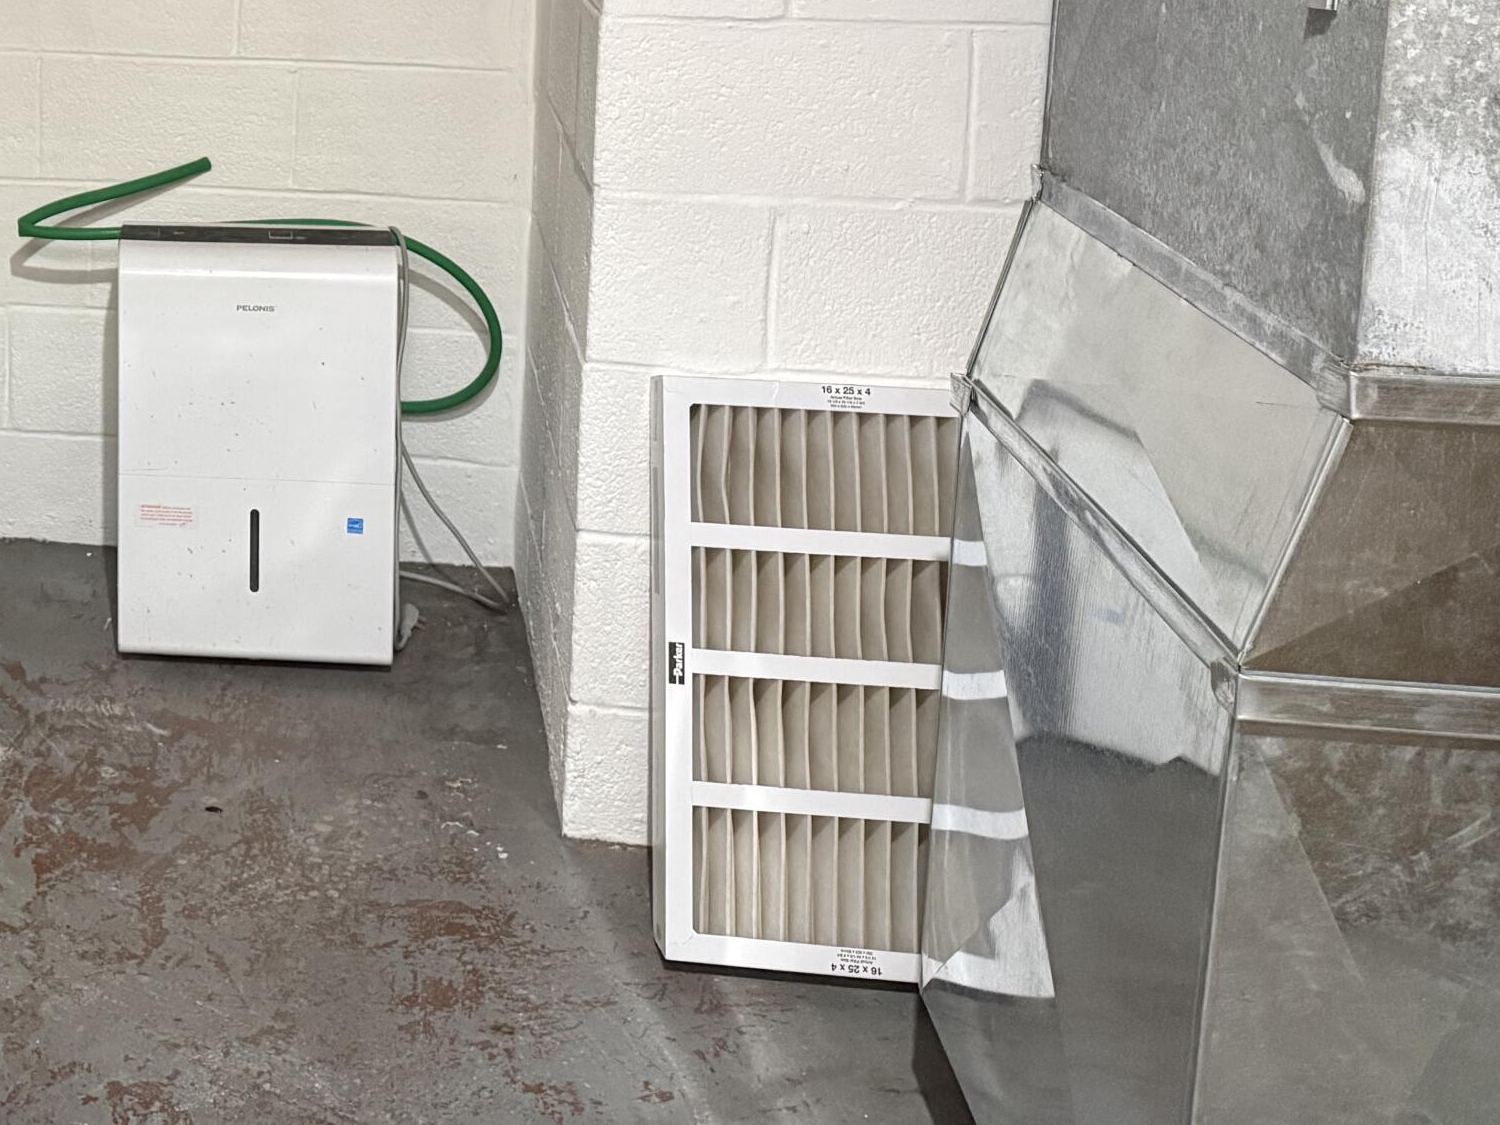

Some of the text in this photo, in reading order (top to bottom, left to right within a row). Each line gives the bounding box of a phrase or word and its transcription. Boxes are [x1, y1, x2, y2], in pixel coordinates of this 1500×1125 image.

[821, 385, 833, 394] 16
[843, 386, 855, 395] 25
[864, 387, 871, 396] 4
[673, 642, 683, 677] Parker
[831, 963, 837, 971] 4
[840, 963, 846, 971] x
[848, 964, 860, 974] 25
[871, 966, 883, 976] 16
